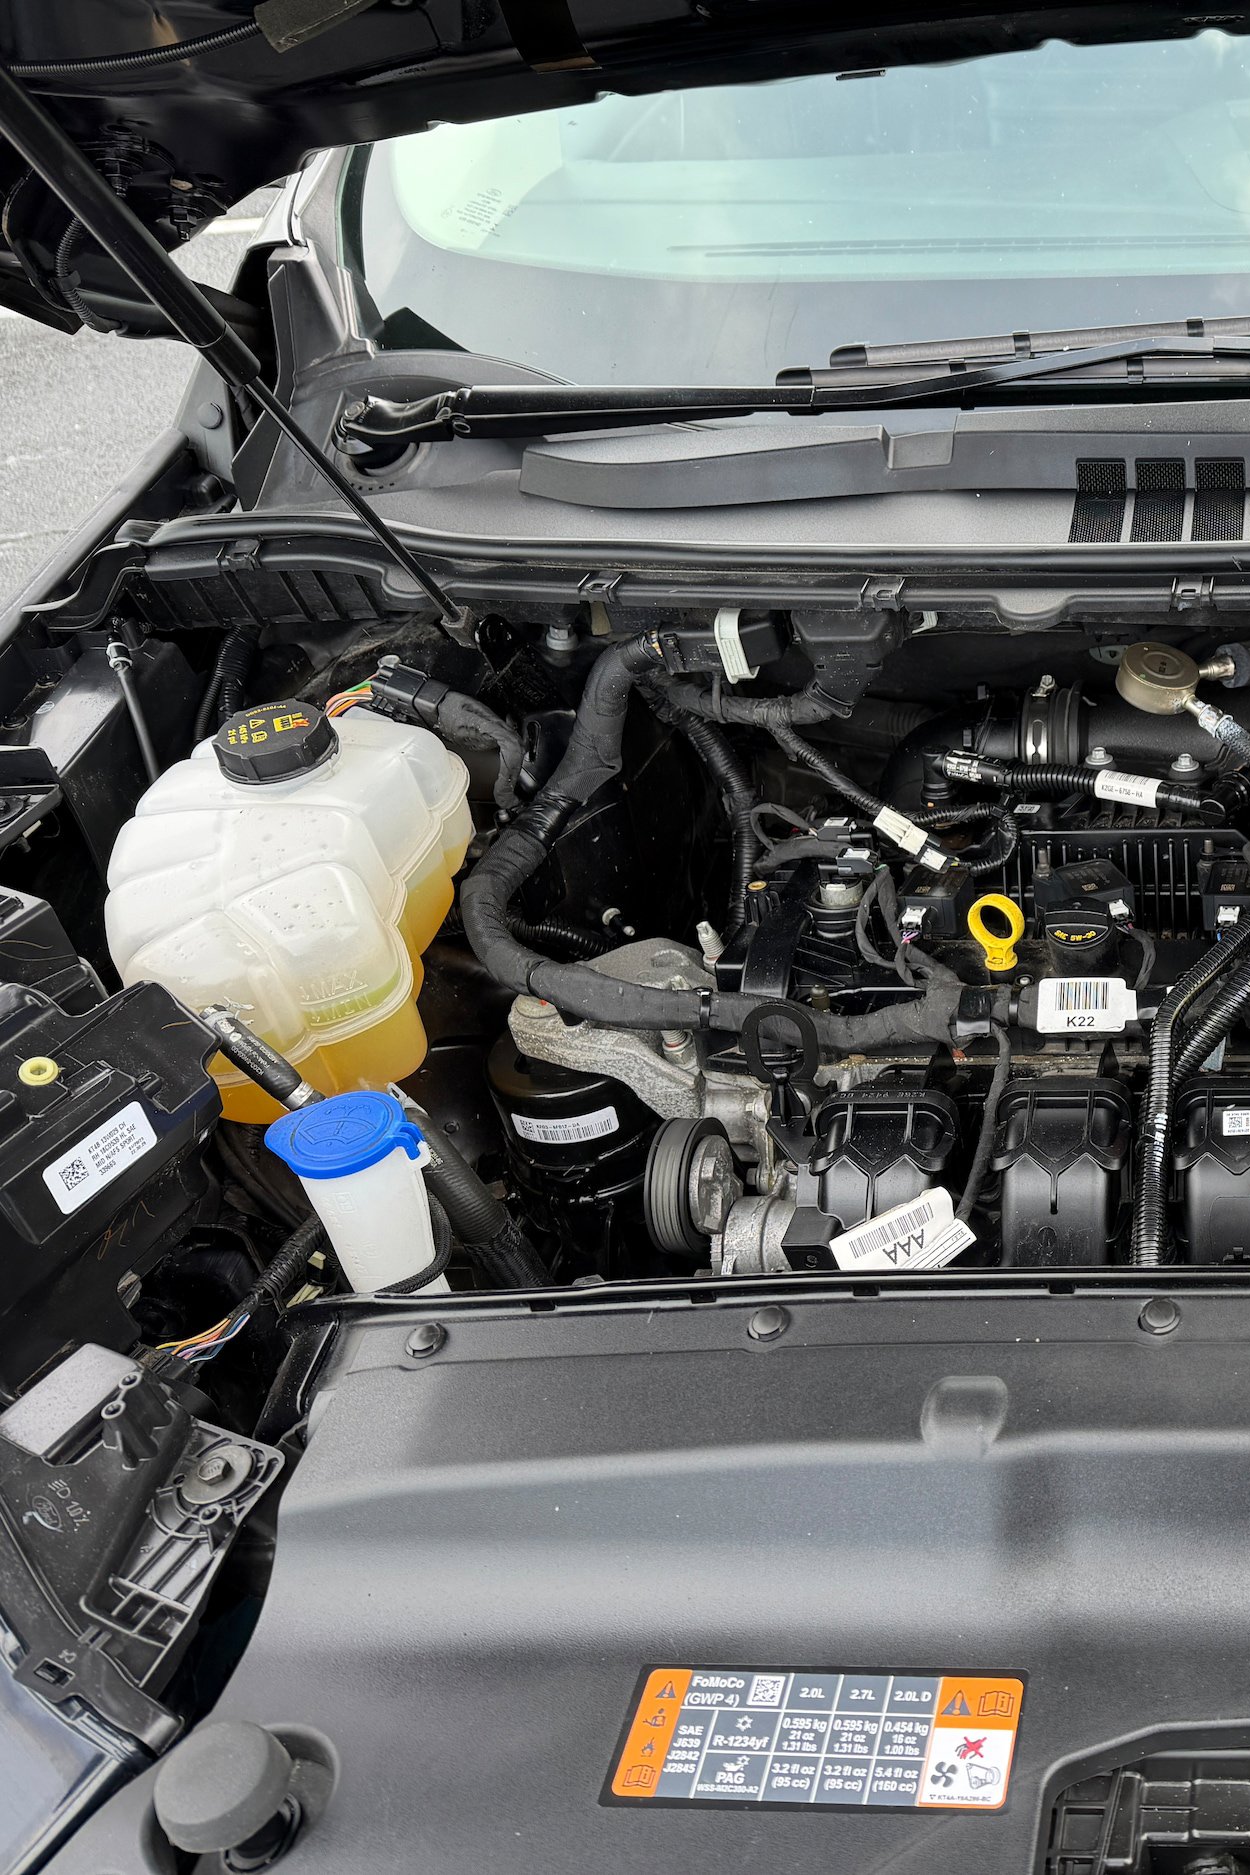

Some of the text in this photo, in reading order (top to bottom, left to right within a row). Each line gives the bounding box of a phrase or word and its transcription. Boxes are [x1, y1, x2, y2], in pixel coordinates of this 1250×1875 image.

[311, 969, 364, 999] MAX
[321, 992, 372, 1021] MIN
[1066, 1016, 1095, 1027] K22
[882, 1228, 924, 1265] AAA
[691, 1675, 745, 1689] FoMoCo
[799, 1687, 826, 1699] 2.0L
[849, 1689, 876, 1700] 2.7L
[893, 1690, 932, 1702] 2.0L D
[684, 1692, 740, 1707] (GWP 4)
[677, 1725, 705, 1736] SAE
[782, 1717, 827, 1733] 0.595 kg
[832, 1719, 878, 1735] 0.595 kg
[883, 1721, 929, 1737] 0.454 kg
[788, 1730, 815, 1741] 21 oz
[839, 1732, 866, 1743] 21 oz
[904, 1736, 917, 1745] oz
[672, 1738, 701, 1748] J639
[712, 1735, 769, 1750] R-1234yf
[782, 1741, 817, 1752] 1.31 lbs
[833, 1743, 869, 1754] 1.31 lbs
[666, 1750, 700, 1761] J2842
[884, 1745, 920, 1756] 1.00 lbs
[662, 1763, 696, 1773] J2845
[771, 1763, 815, 1775] 3.2 fl oz
[823, 1765, 867, 1777] 3.2 fl oz
[874, 1767, 919, 1779] 5.4 fl oz
[715, 1771, 746, 1784] PAG
[771, 1777, 810, 1790] (95 cc)
[823, 1779, 862, 1792] (95 cc)
[872, 1780, 917, 1794] (160 cc)
